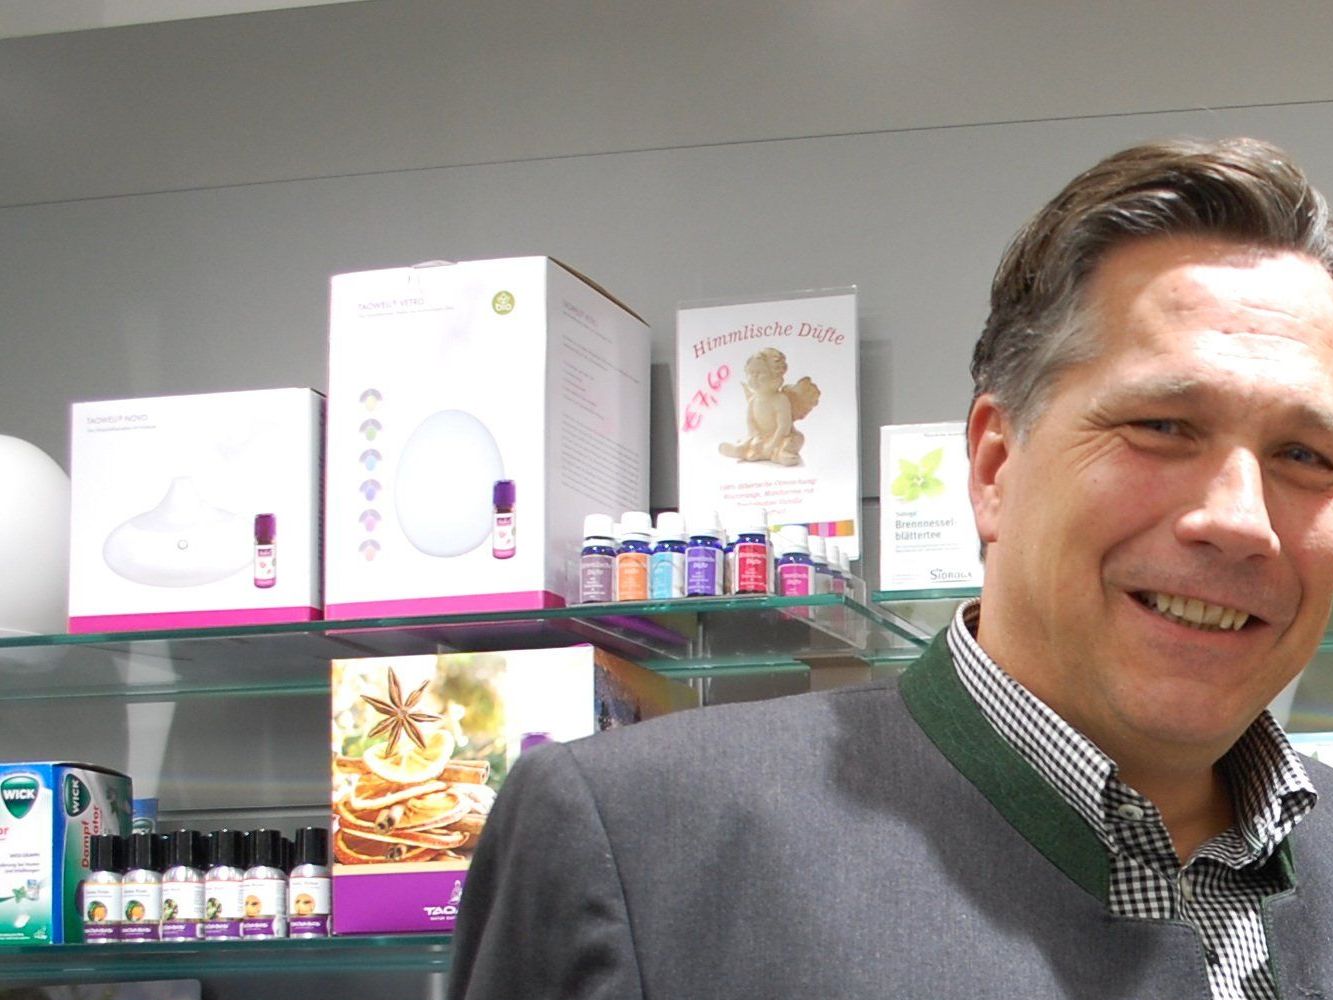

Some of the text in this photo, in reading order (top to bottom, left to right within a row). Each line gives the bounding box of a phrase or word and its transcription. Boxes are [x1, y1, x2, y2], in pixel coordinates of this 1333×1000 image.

[693, 321, 845, 359] Himmlische Düfte
[895, 530, 942, 542] blättertee
[3, 788, 36, 800] WICK
[72, 779, 80, 814] WICK
[81, 820, 91, 869] Dampf
